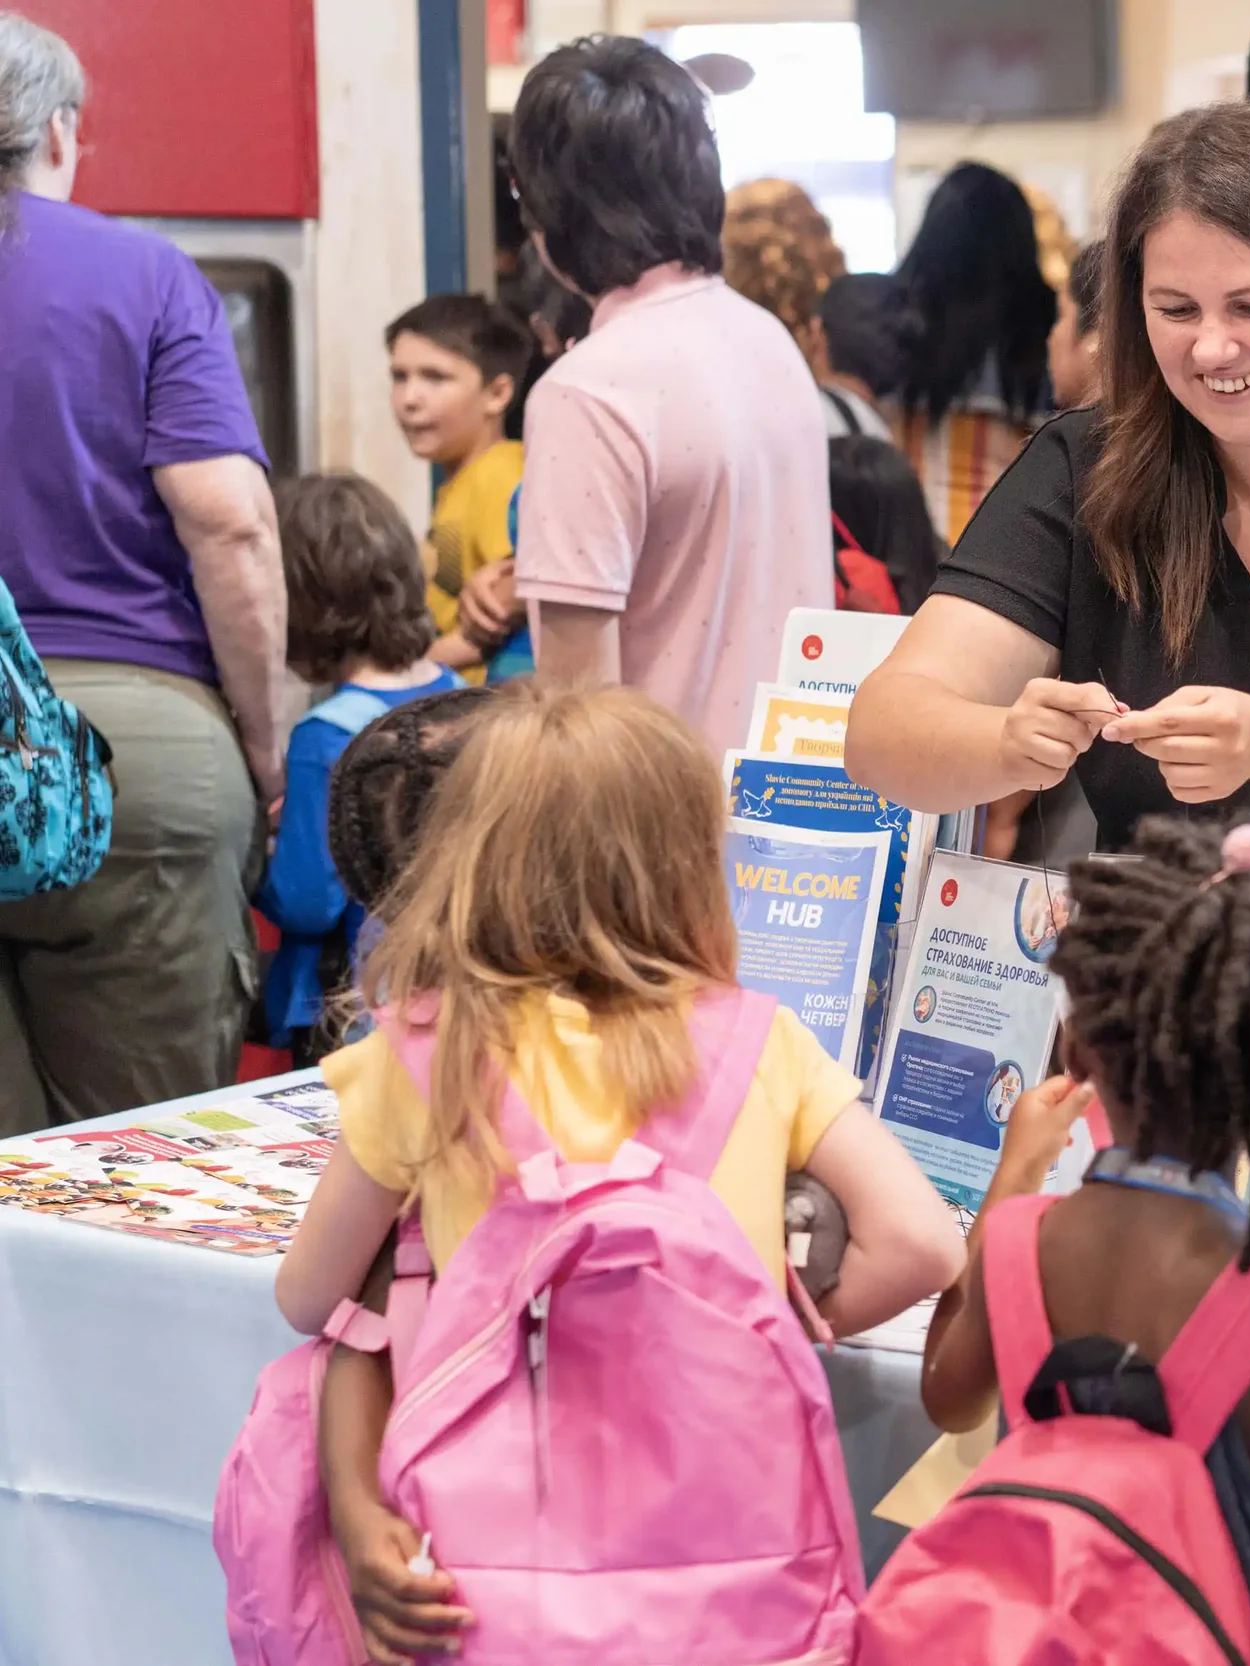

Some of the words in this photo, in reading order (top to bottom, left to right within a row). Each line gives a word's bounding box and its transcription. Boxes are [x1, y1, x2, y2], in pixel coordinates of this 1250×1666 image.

[765, 773, 786, 784] Slavic
[786, 776, 825, 789] Community
[826, 779, 849, 790] Center
[734, 862, 861, 900] WELCOME
[766, 900, 823, 928] HUB
[930, 927, 988, 951] ДОСТУПНОЕ
[921, 965, 936, 977] ДЛЯ
[936, 968, 949, 980] ВАС
[949, 971, 955, 980] И
[956, 972, 979, 986] ВАШЕЙ
[979, 978, 1002, 991] СЕМЬИ
[926, 947, 993, 975] СТРАХОВАНИЕ
[994, 963, 1049, 987] ЗДОРОВЬЯ
[804, 993, 849, 1010] КОЖЕН
[801, 1010, 846, 1027] ЧЕТВЕР
